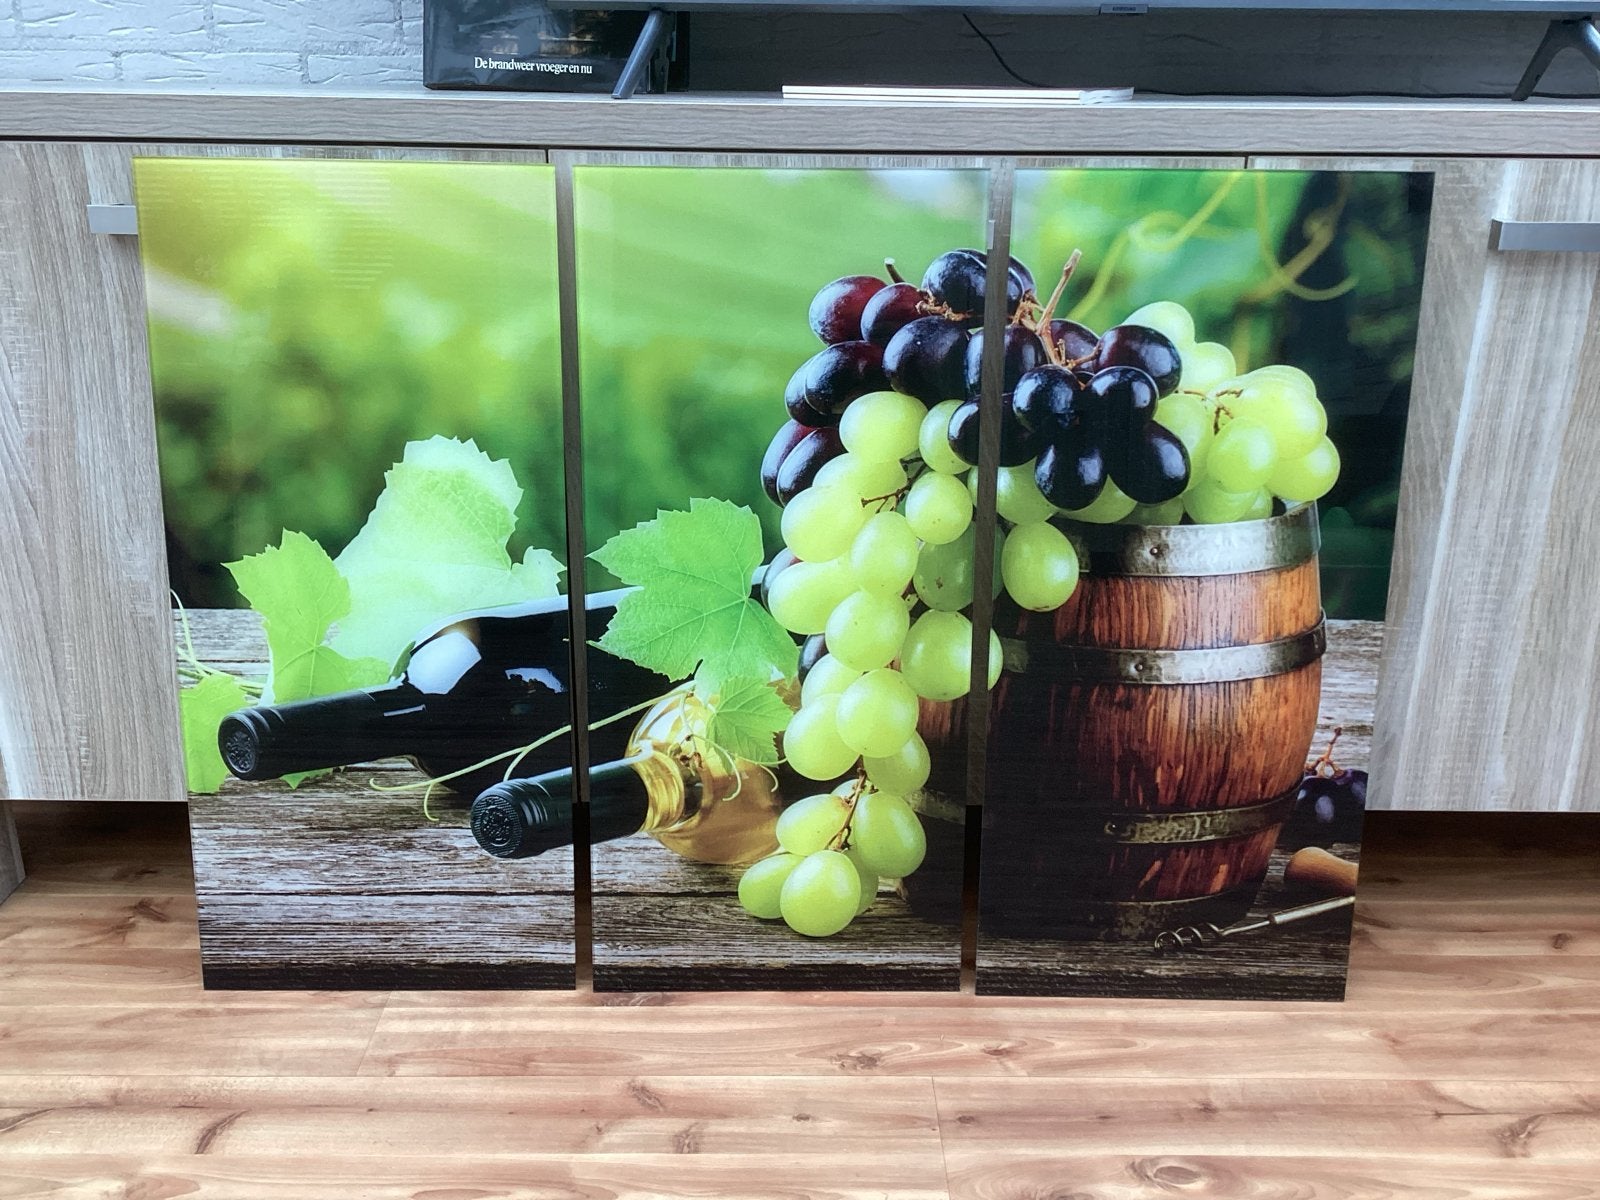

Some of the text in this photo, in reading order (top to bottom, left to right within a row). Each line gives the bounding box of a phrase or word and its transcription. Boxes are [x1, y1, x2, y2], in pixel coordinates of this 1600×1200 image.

[474, 57, 593, 75] De brandweer vroeger en nu
